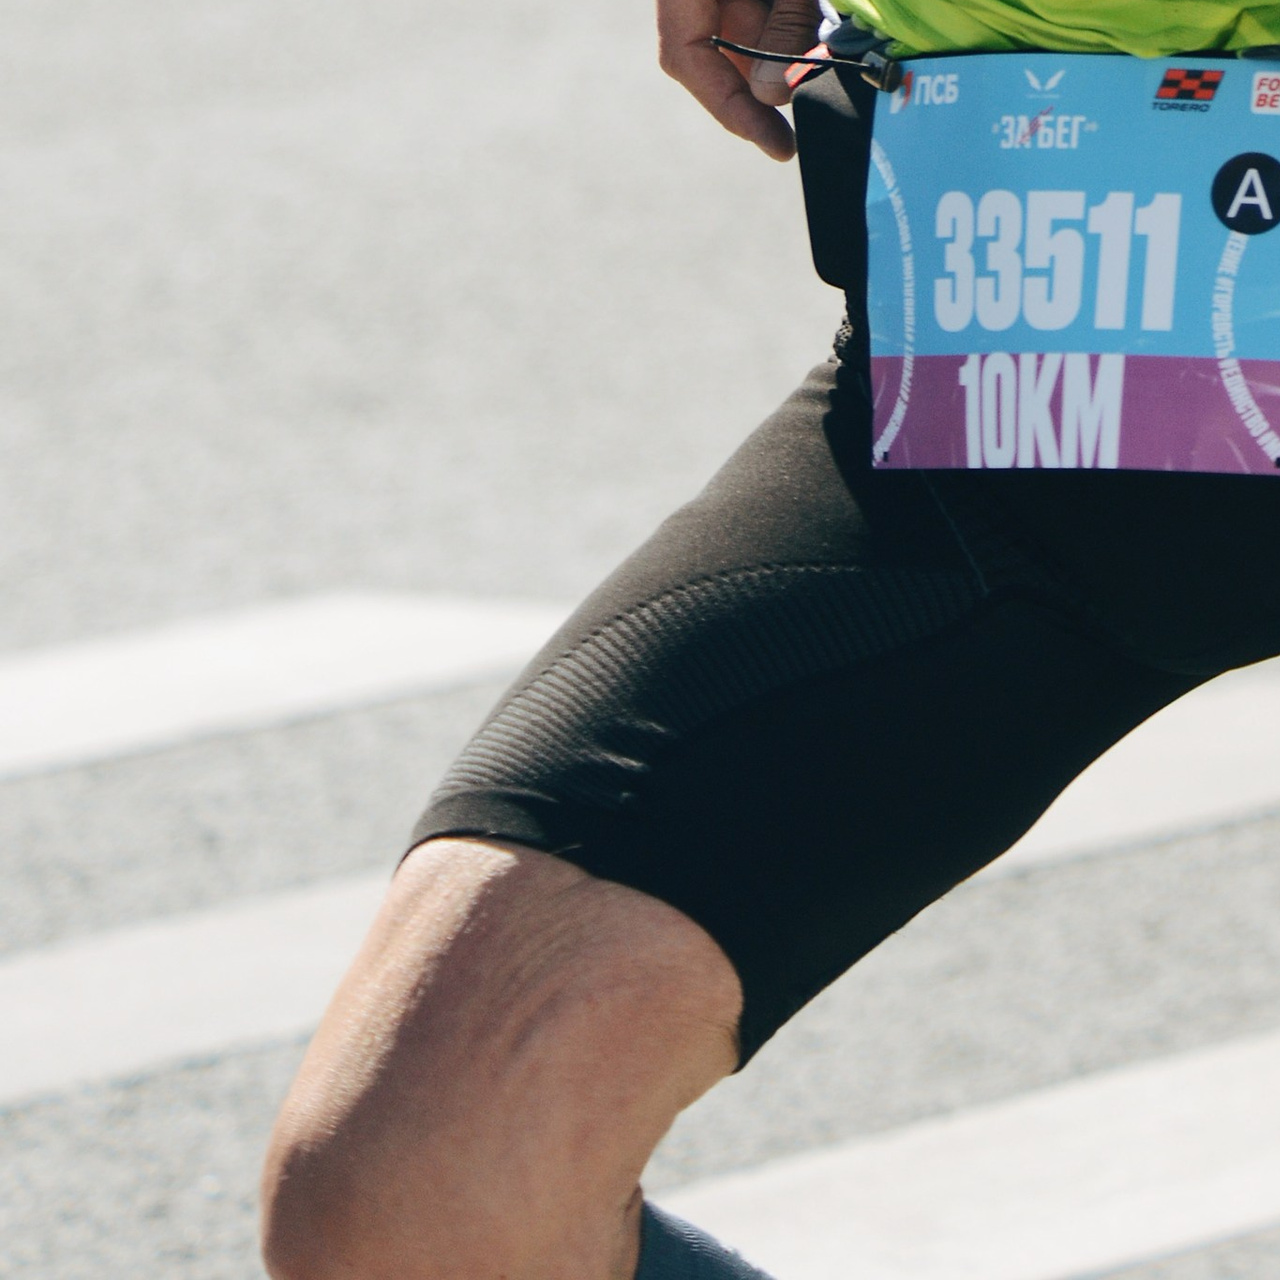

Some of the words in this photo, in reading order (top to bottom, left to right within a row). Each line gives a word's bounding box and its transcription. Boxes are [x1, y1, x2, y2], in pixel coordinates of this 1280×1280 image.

[914, 73, 959, 105] ПСБ
[1152, 102, 1211, 113] TORERO
[1226, 168, 1273, 220] A
[934, 189, 1183, 333] 33511
